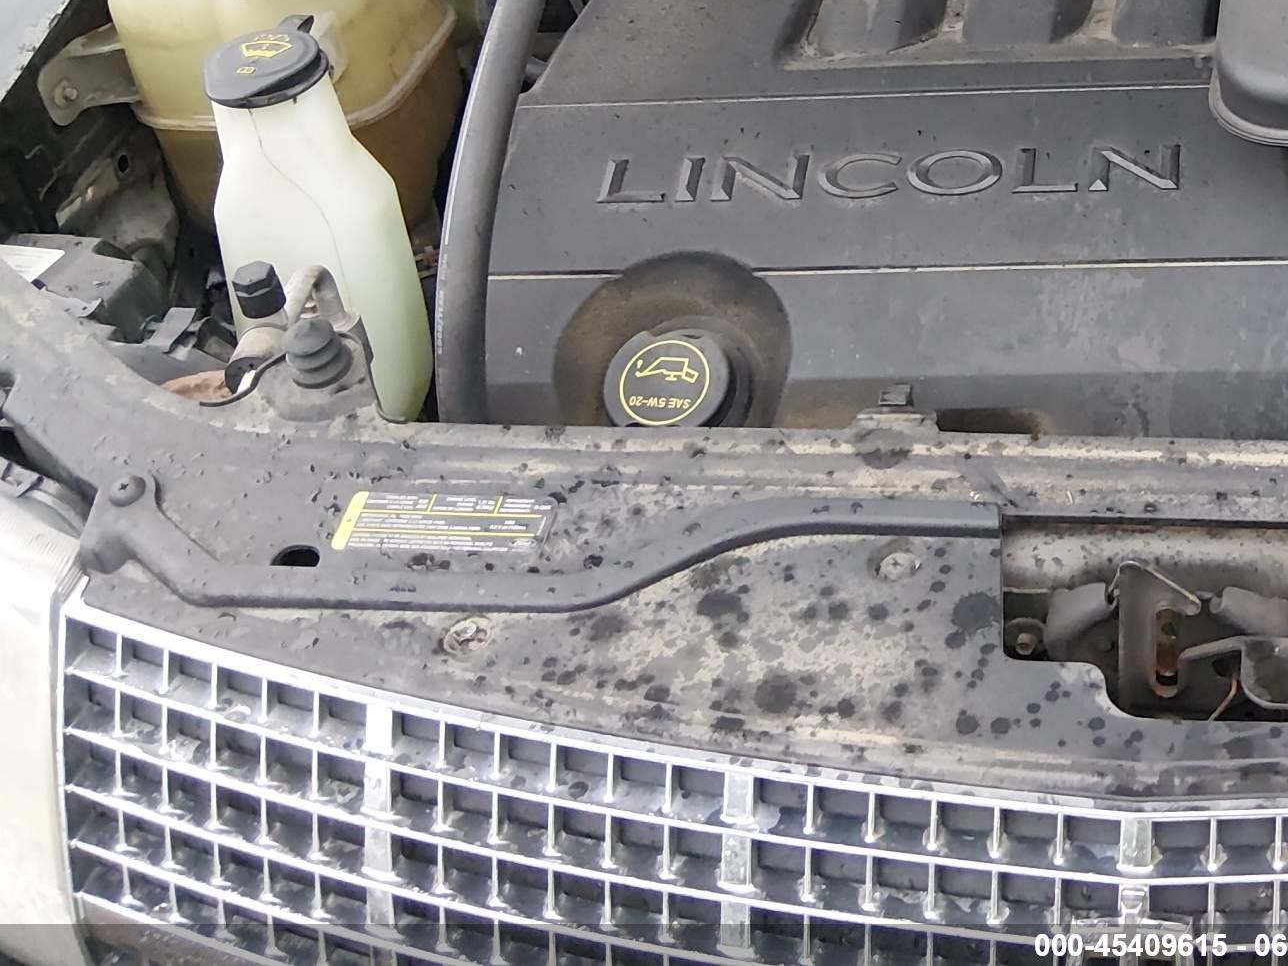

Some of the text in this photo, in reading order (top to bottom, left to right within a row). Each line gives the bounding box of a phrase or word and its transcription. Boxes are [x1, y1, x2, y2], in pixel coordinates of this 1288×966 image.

[595, 144, 1181, 203] LINCOLN
[629, 395, 691, 409] SAE 5W-20
